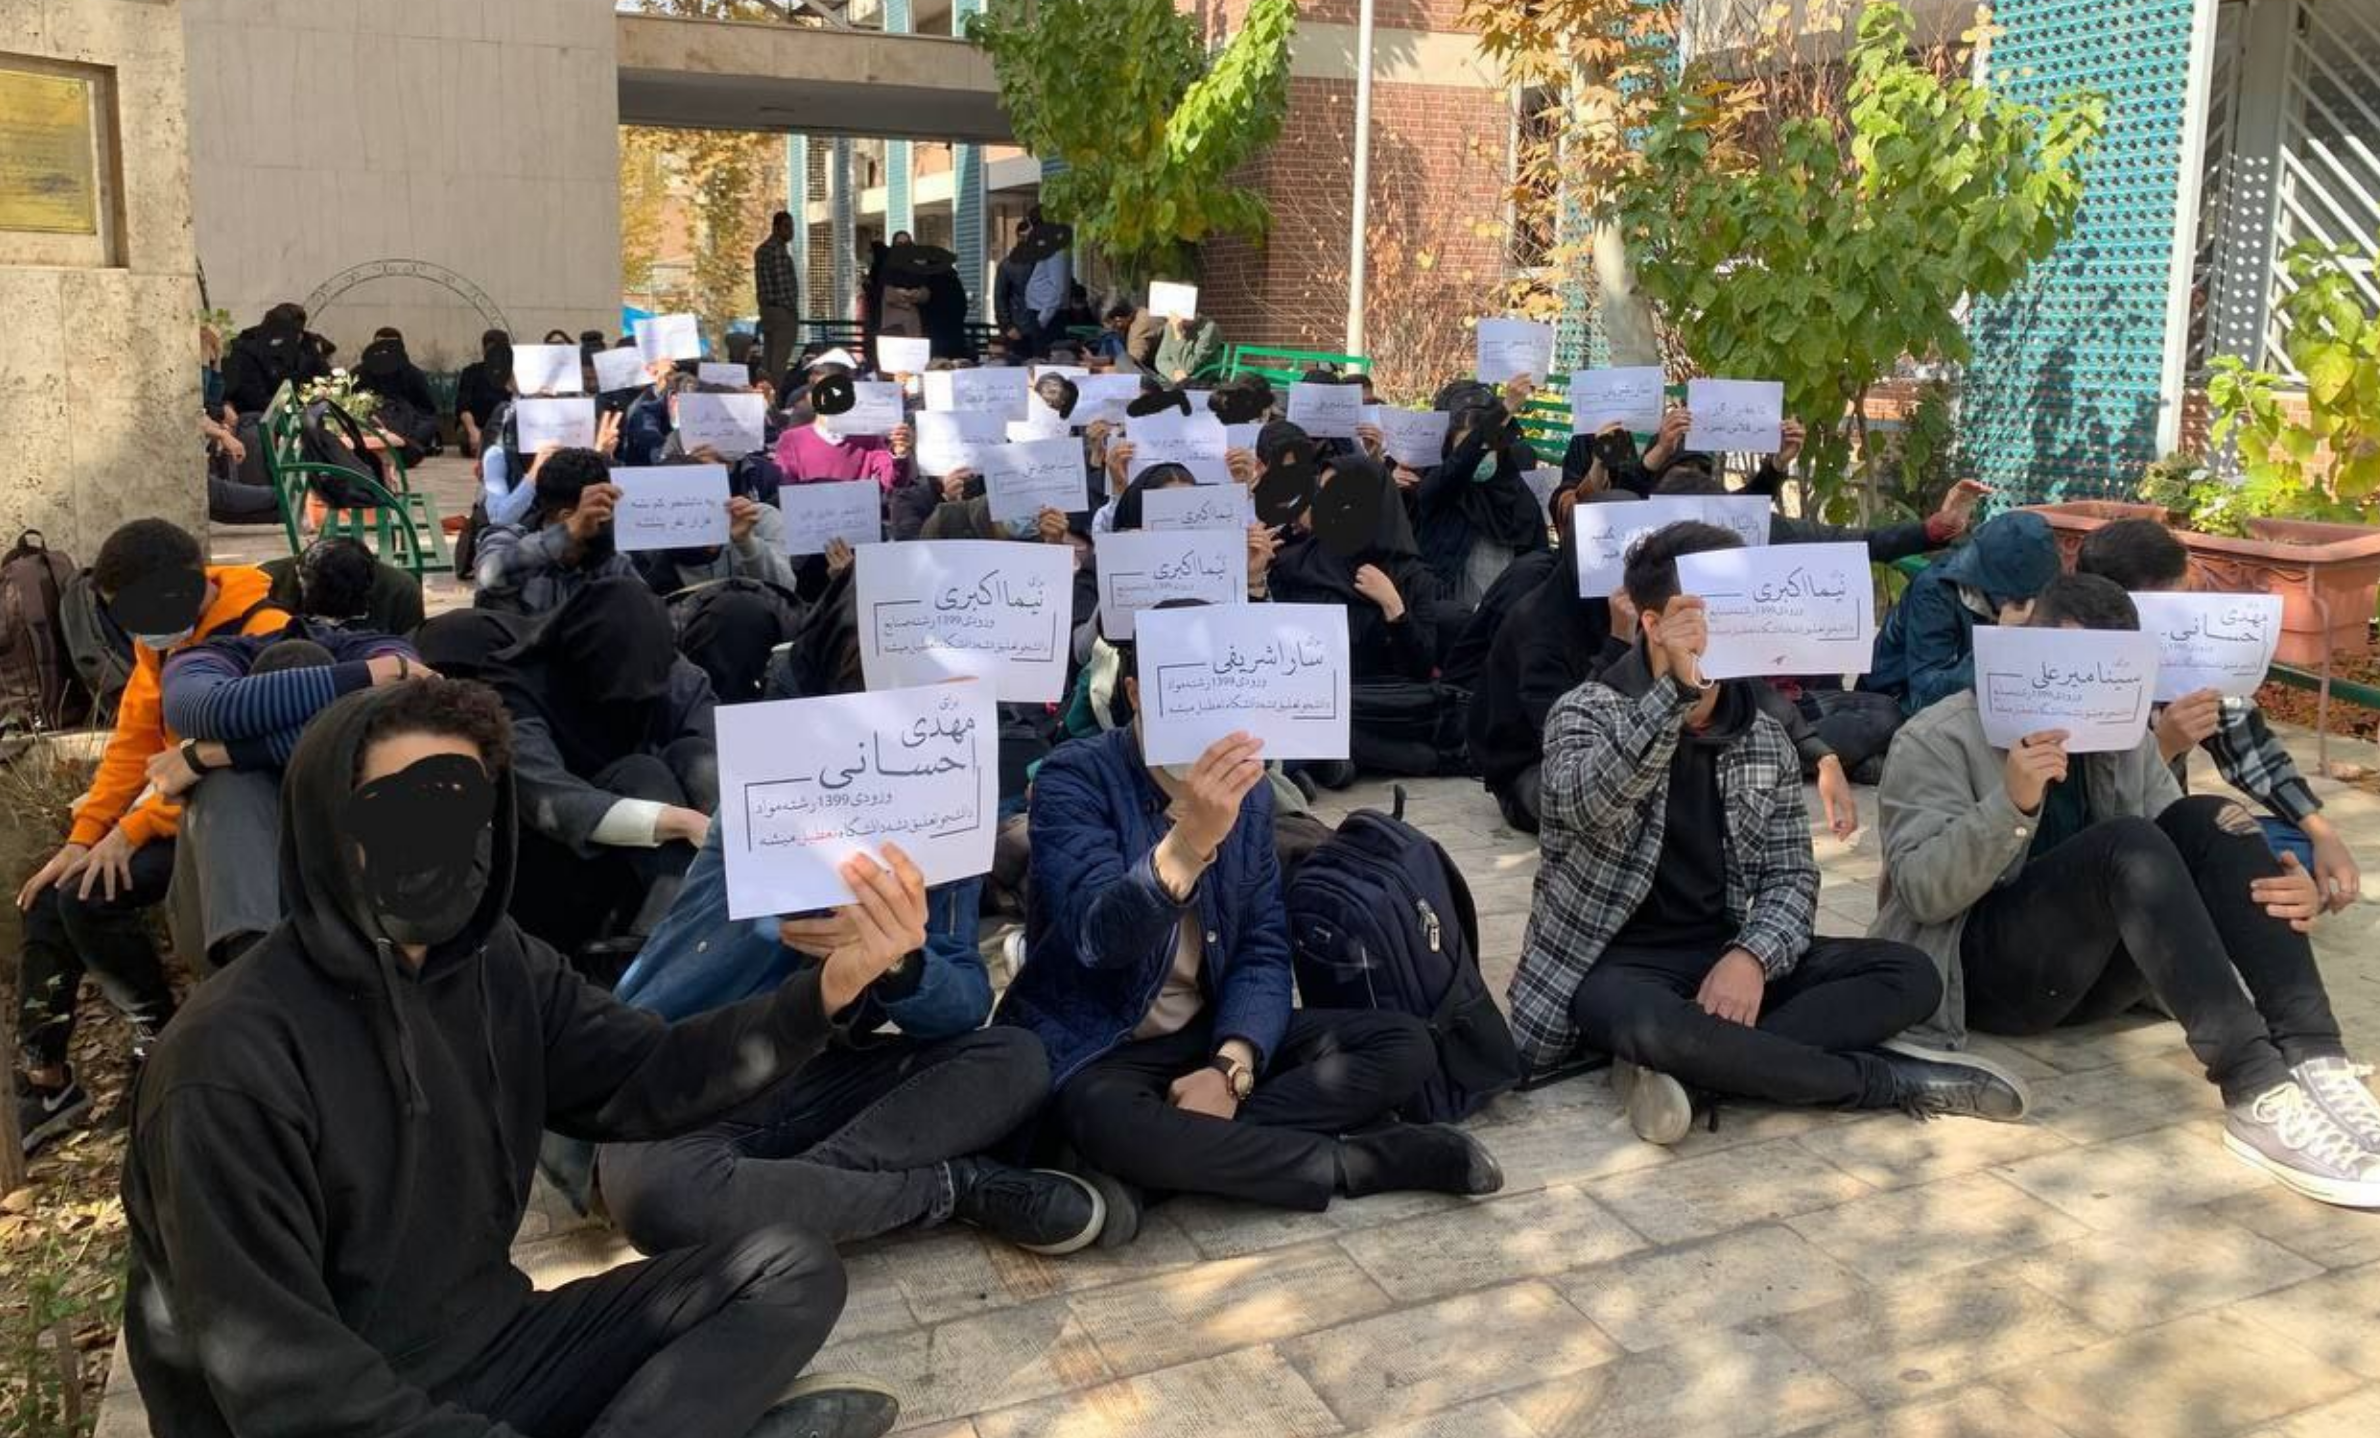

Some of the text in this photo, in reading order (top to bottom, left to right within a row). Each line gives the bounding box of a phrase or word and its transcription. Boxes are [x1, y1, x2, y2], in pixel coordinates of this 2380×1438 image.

[934, 568, 1044, 616] نیما اکبری
[1753, 565, 1847, 603] نیما اکبری
[1212, 640, 1325, 676] سارا شریفی
[901, 713, 977, 748] مهدی
[818, 730, 977, 790] احسانی
[756, 791, 893, 819] ورودی 1399 رشته مواد
